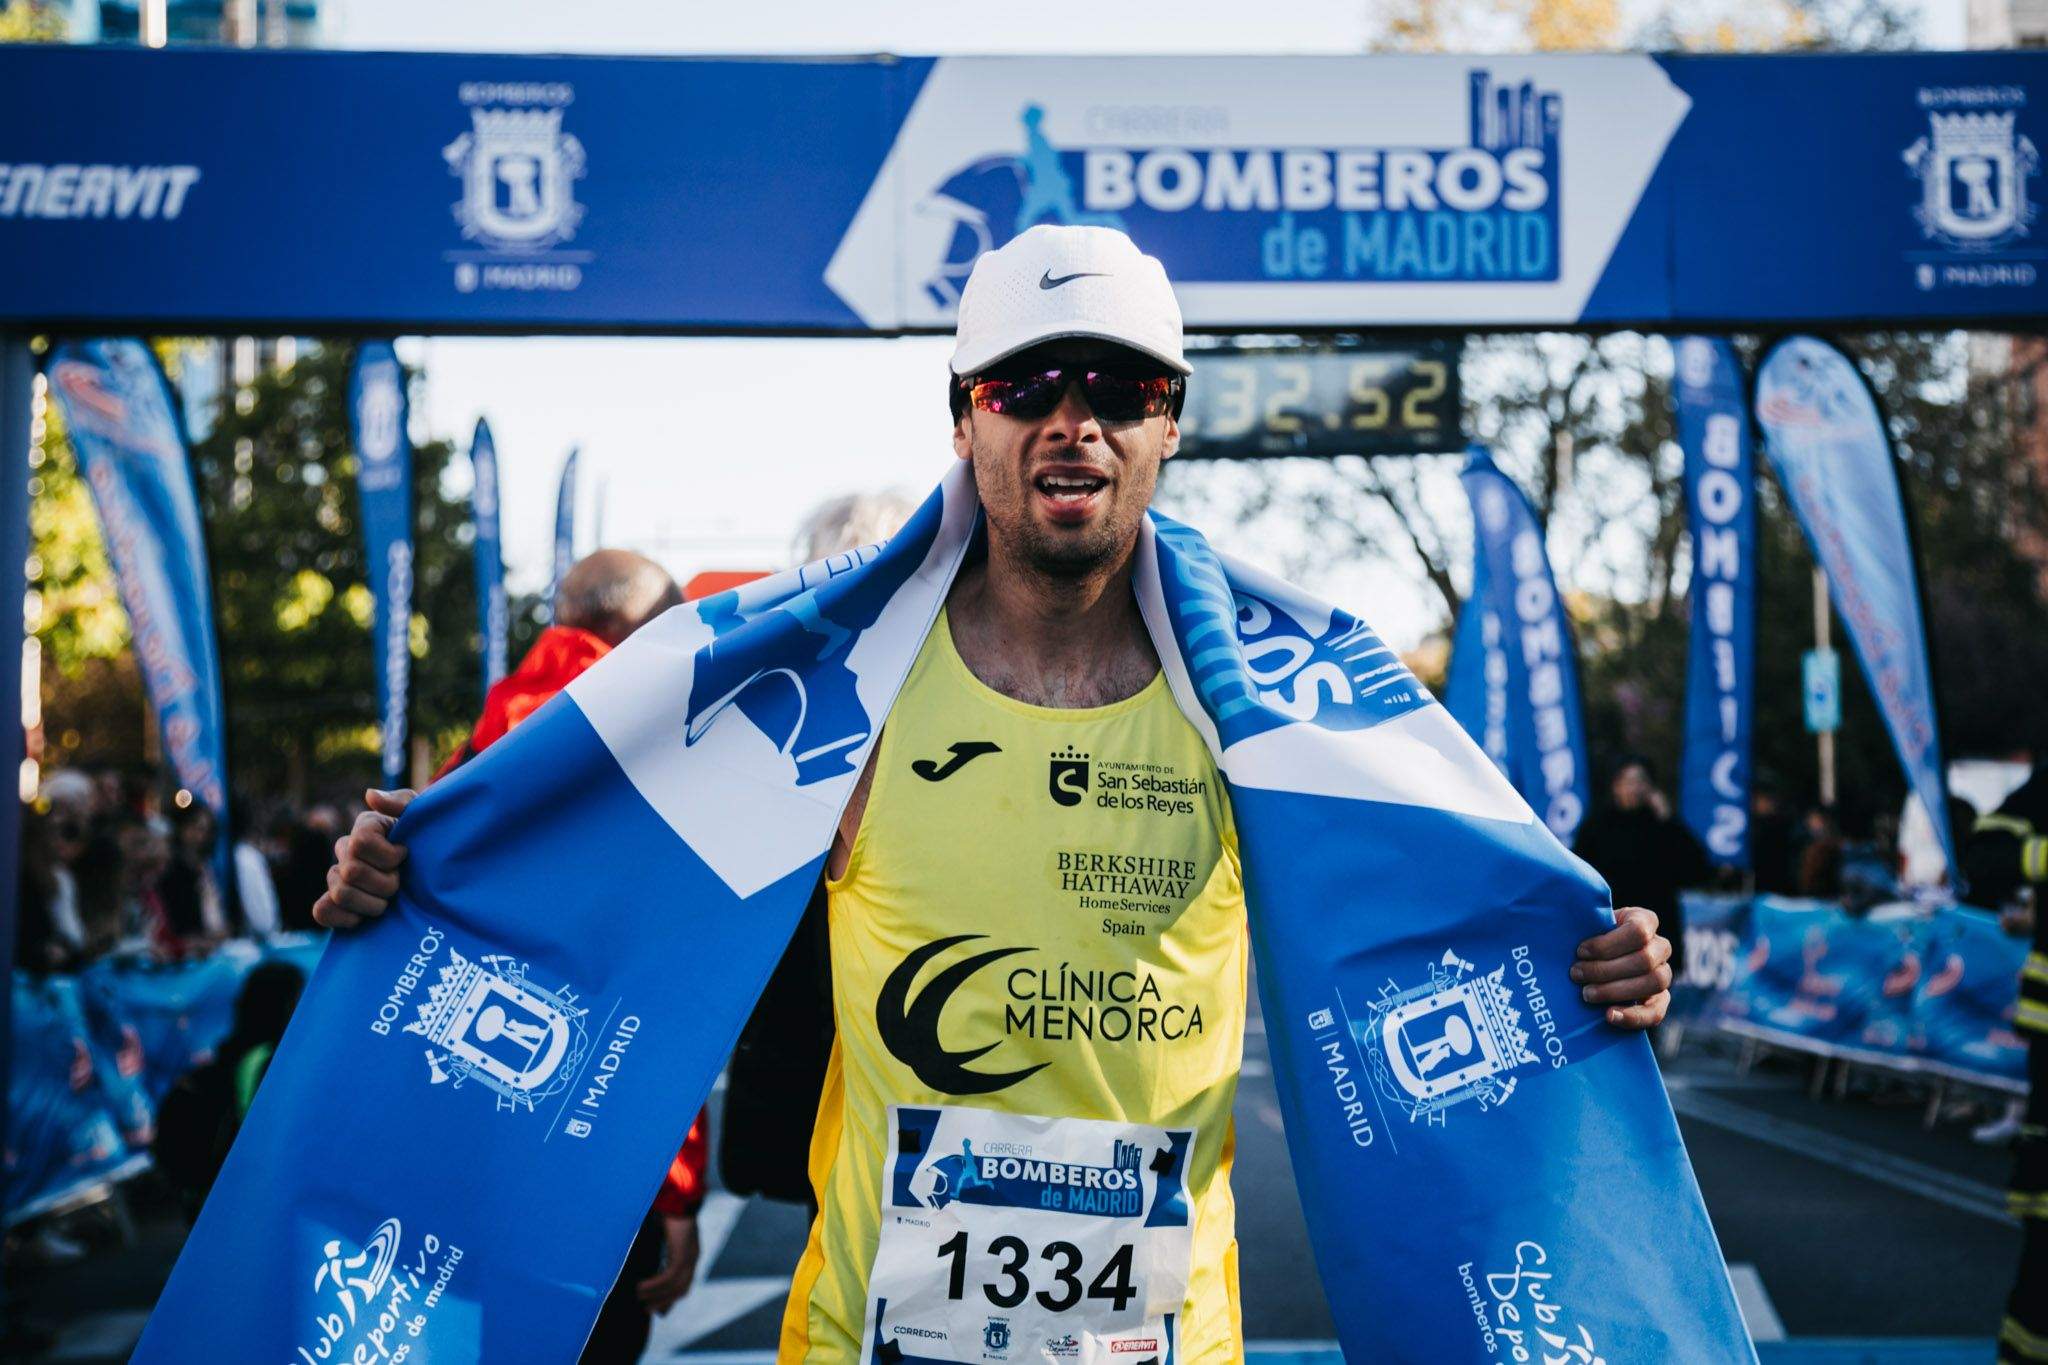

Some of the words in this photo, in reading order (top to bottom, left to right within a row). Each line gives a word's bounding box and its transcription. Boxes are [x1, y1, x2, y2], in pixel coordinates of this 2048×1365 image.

[1083, 146, 1551, 213] BOMBEROS
[1261, 213, 1329, 277] de
[1343, 212, 1549, 278] MADRID
[1097, 762, 1162, 774] AYUNTAMIENTO
[1163, 766, 1175, 774] DE
[1097, 771, 1127, 790] San
[1132, 774, 1208, 796] Sebastián
[1096, 791, 1118, 809] de
[1121, 793, 1144, 810] los
[1147, 794, 1194, 816] Reyes
[1057, 852, 1196, 880] BERKSHIRE
[1061, 873, 1191, 899] HATHAWAY
[1079, 896, 1171, 914] HomeServices
[1102, 918, 1146, 937] Spain
[371, 926, 444, 1035] BOMBEROS
[1007, 962, 1162, 1003] CLÍNICA
[1004, 1003, 1203, 1042] MENORCA
[1512, 946, 1568, 1069] BOMBEROS
[582, 1014, 641, 1108] MADRID
[1321, 1040, 1374, 1147] MADRID
[984, 1142, 1033, 1157] CARRERA
[981, 1157, 1138, 1190] BOMBEROS
[1040, 1185, 1062, 1209] de
[1068, 1186, 1139, 1214] MADRID
[905, 1218, 931, 1228] MADRID
[406, 1314, 427, 1337] de
[424, 1245, 464, 1309] madrid
[936, 1230, 1138, 1313] 1334
[1515, 1241, 1562, 1325] Club
[336, 1234, 441, 1365] eportivo
[1458, 1262, 1498, 1354] bomberos
[1486, 1264, 1530, 1365] Depo
[287, 1313, 345, 1365] lub
